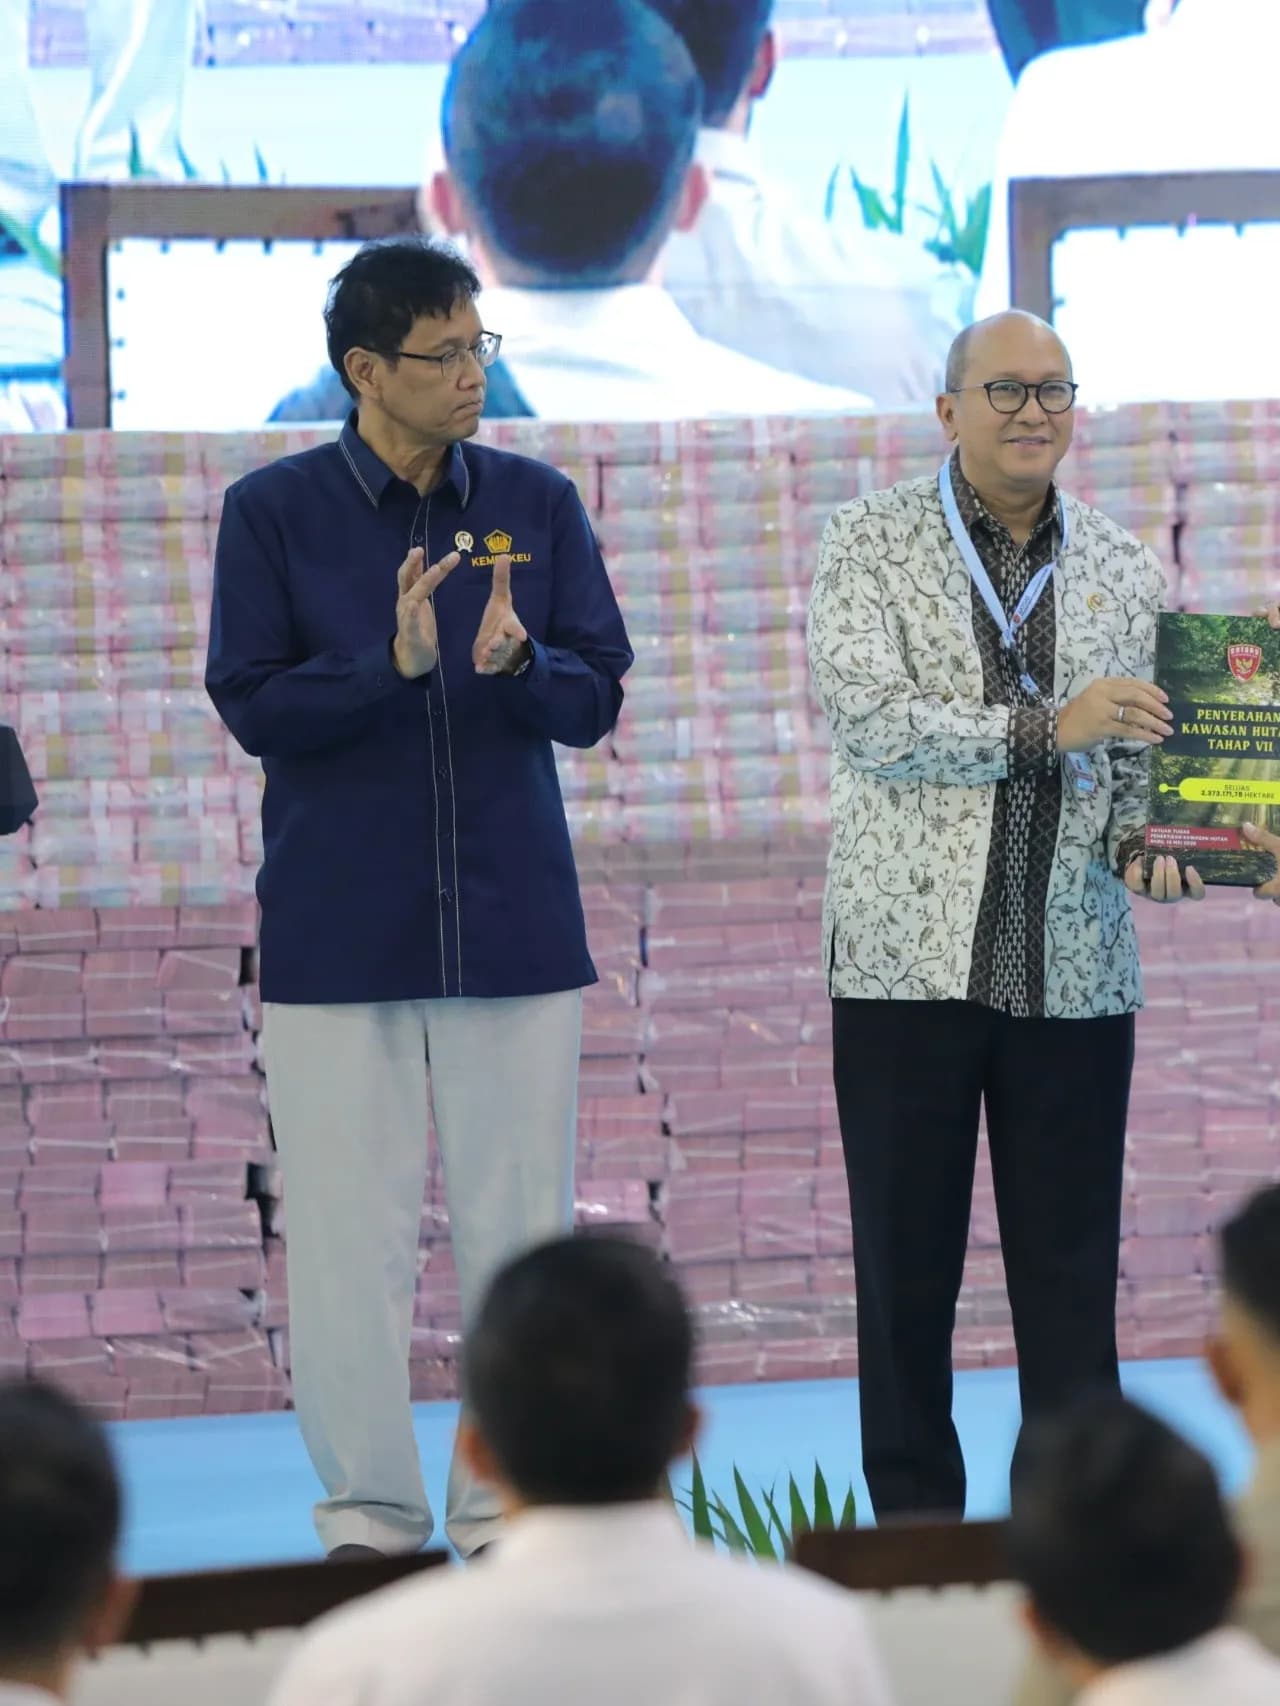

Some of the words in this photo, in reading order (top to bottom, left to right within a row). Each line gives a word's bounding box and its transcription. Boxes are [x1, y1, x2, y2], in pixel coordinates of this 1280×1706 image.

[471, 553, 531, 567] KEMKEU
[1181, 722, 1247, 737] KAWASAN
[1207, 738, 1251, 751] TAHAP
[1255, 741, 1274, 752] VII
